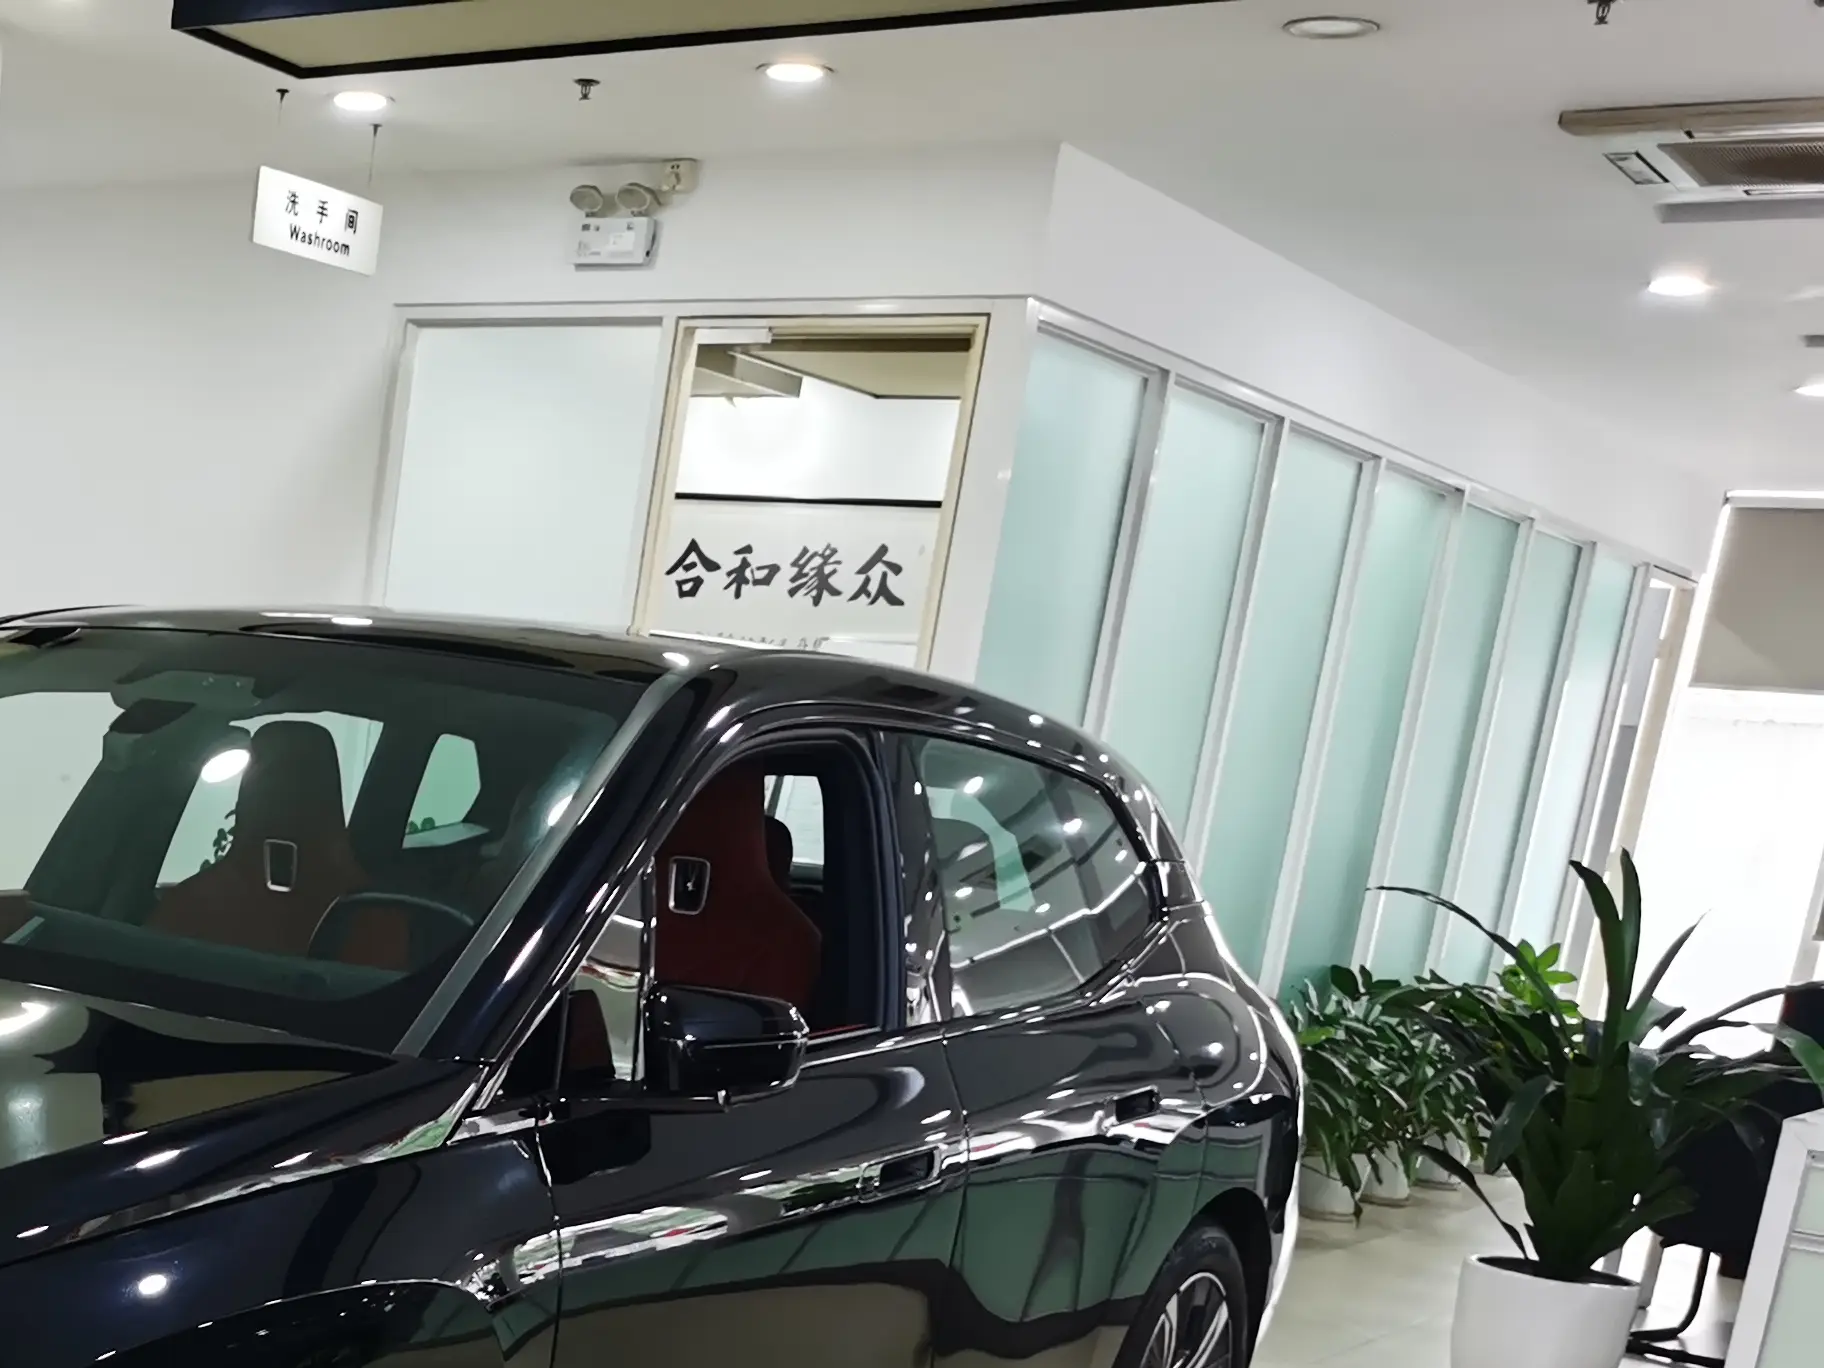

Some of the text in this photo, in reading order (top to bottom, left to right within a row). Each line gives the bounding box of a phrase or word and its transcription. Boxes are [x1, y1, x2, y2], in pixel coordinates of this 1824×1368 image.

[285, 190, 359, 234] 洗手间
[289, 223, 351, 256] Washroom
